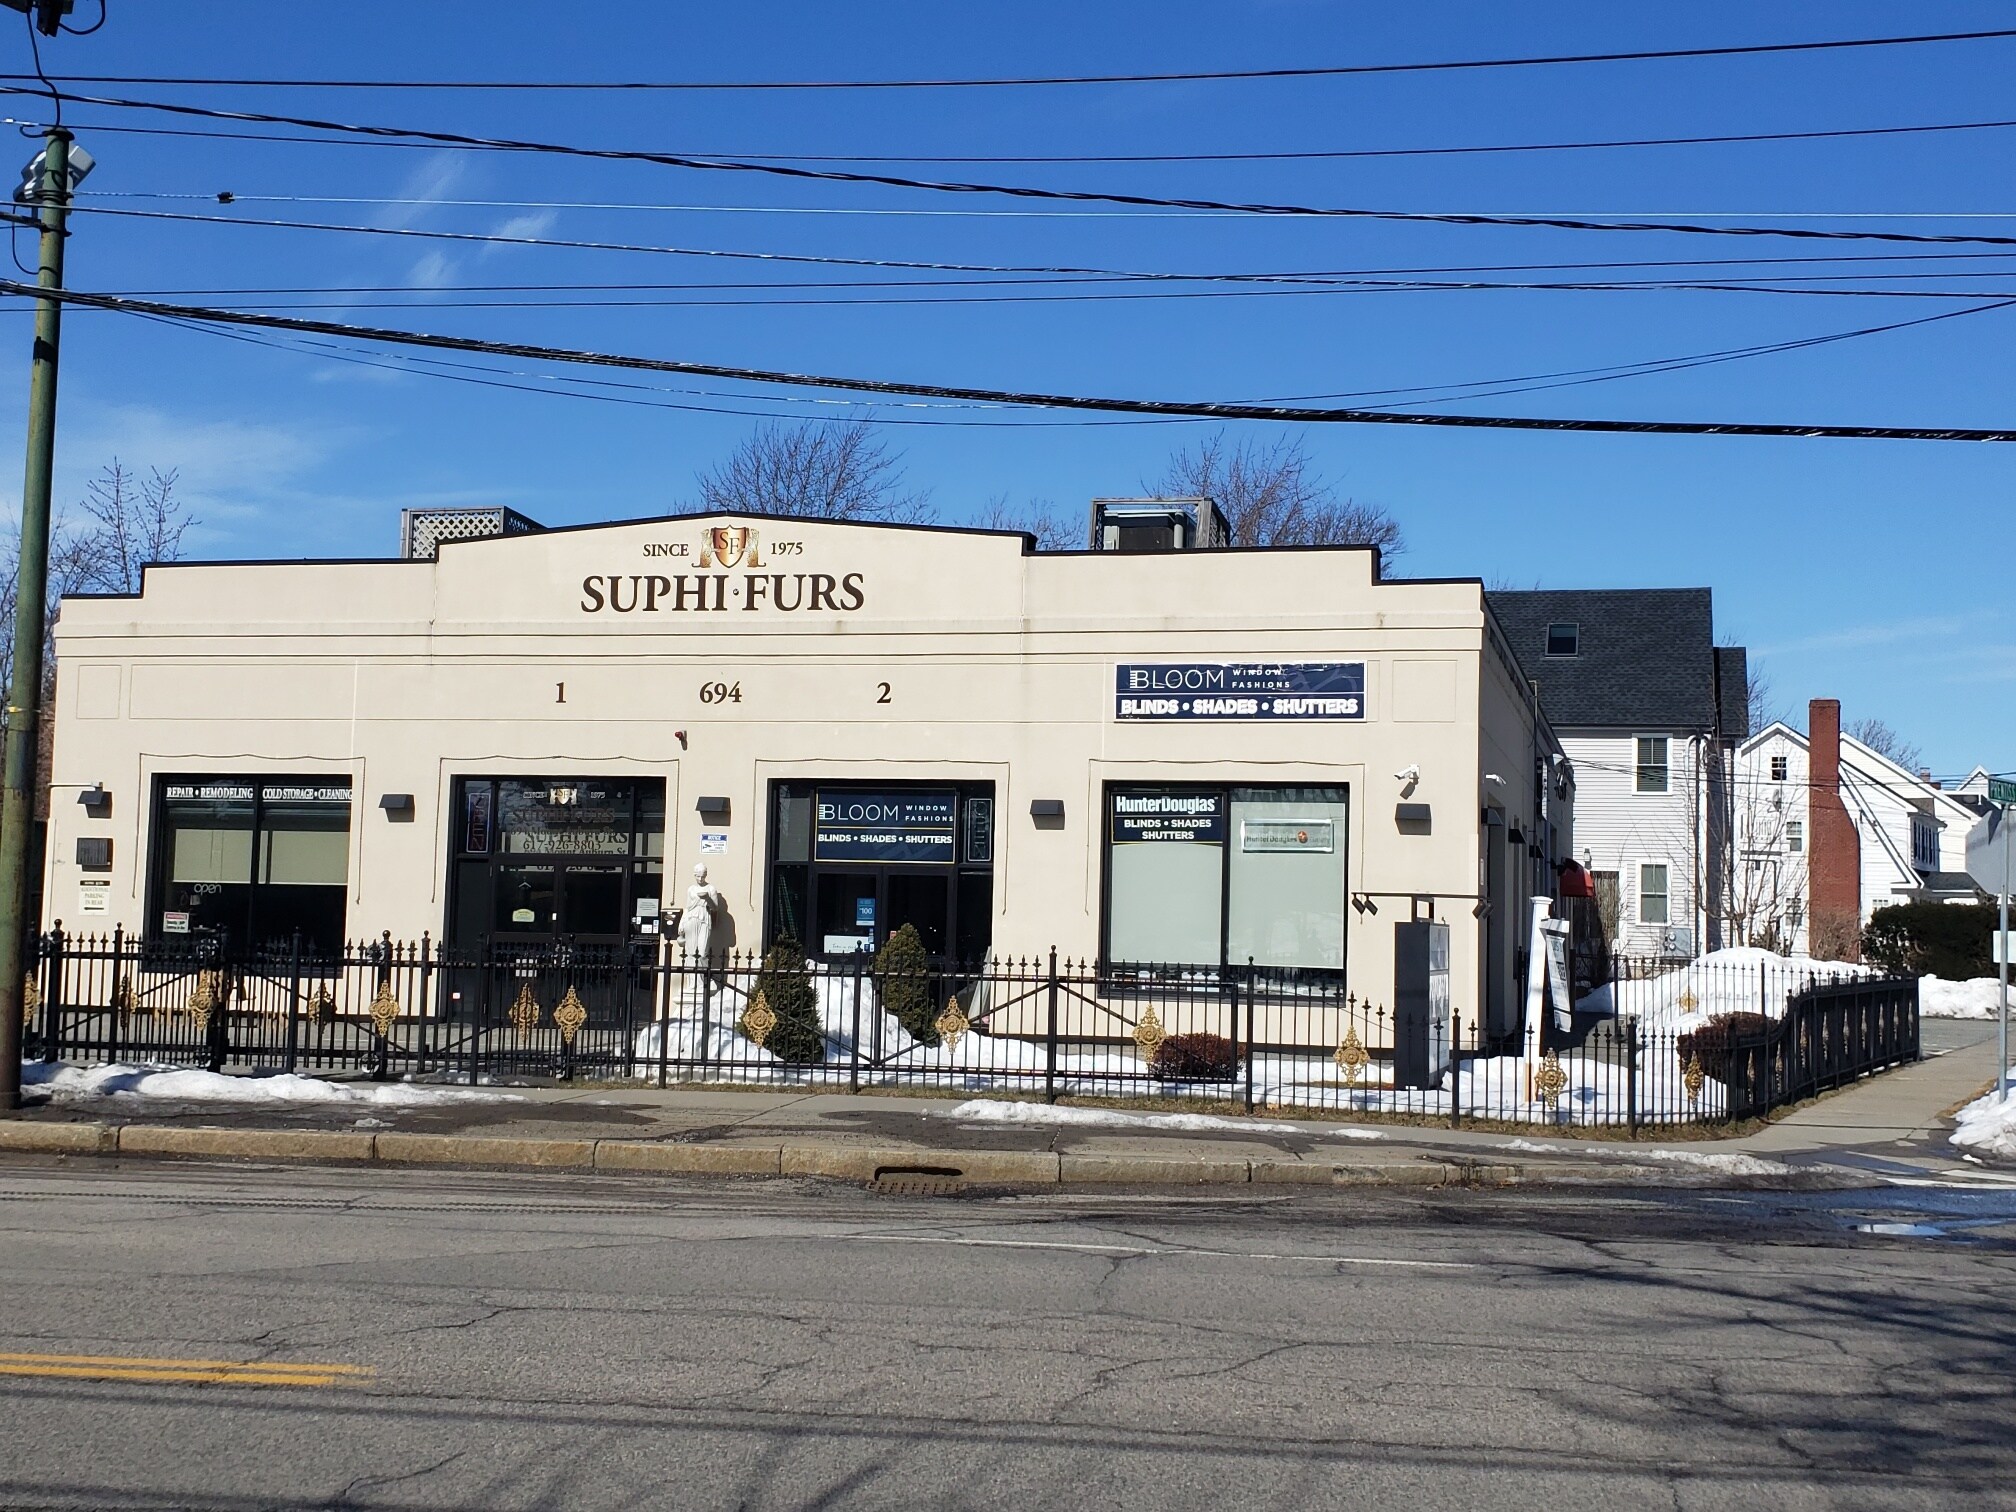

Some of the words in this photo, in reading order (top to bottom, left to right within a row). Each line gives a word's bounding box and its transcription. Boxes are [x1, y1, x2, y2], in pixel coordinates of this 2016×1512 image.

[642, 543, 690, 557] SINCE
[769, 541, 804, 556] 1975
[1129, 669, 1224, 689] BLOOM
[1231, 681, 1291, 689] FASHIONS
[555, 681, 567, 704] 1
[699, 680, 743, 705] 694
[876, 682, 892, 704] 2
[1120, 699, 1180, 715] BLINDS
[1192, 698, 1258, 715] SHADES
[1272, 698, 1359, 715] SHUTTERS
[166, 786, 194, 798] REPAIR
[200, 787, 254, 799] REMODELING
[262, 788, 282, 799] COLD
[282, 788, 314, 800] STORAGE
[818, 803, 899, 821] BLOOM
[1123, 819, 1162, 828] BLINDS
[1170, 819, 1212, 828] SHADES
[817, 834, 852, 843] BLINDS
[859, 835, 897, 843] SHADES
[904, 835, 953, 844] SHUTTERS
[1141, 830, 1195, 840] SHUTTERS
[193, 883, 222, 896] open
